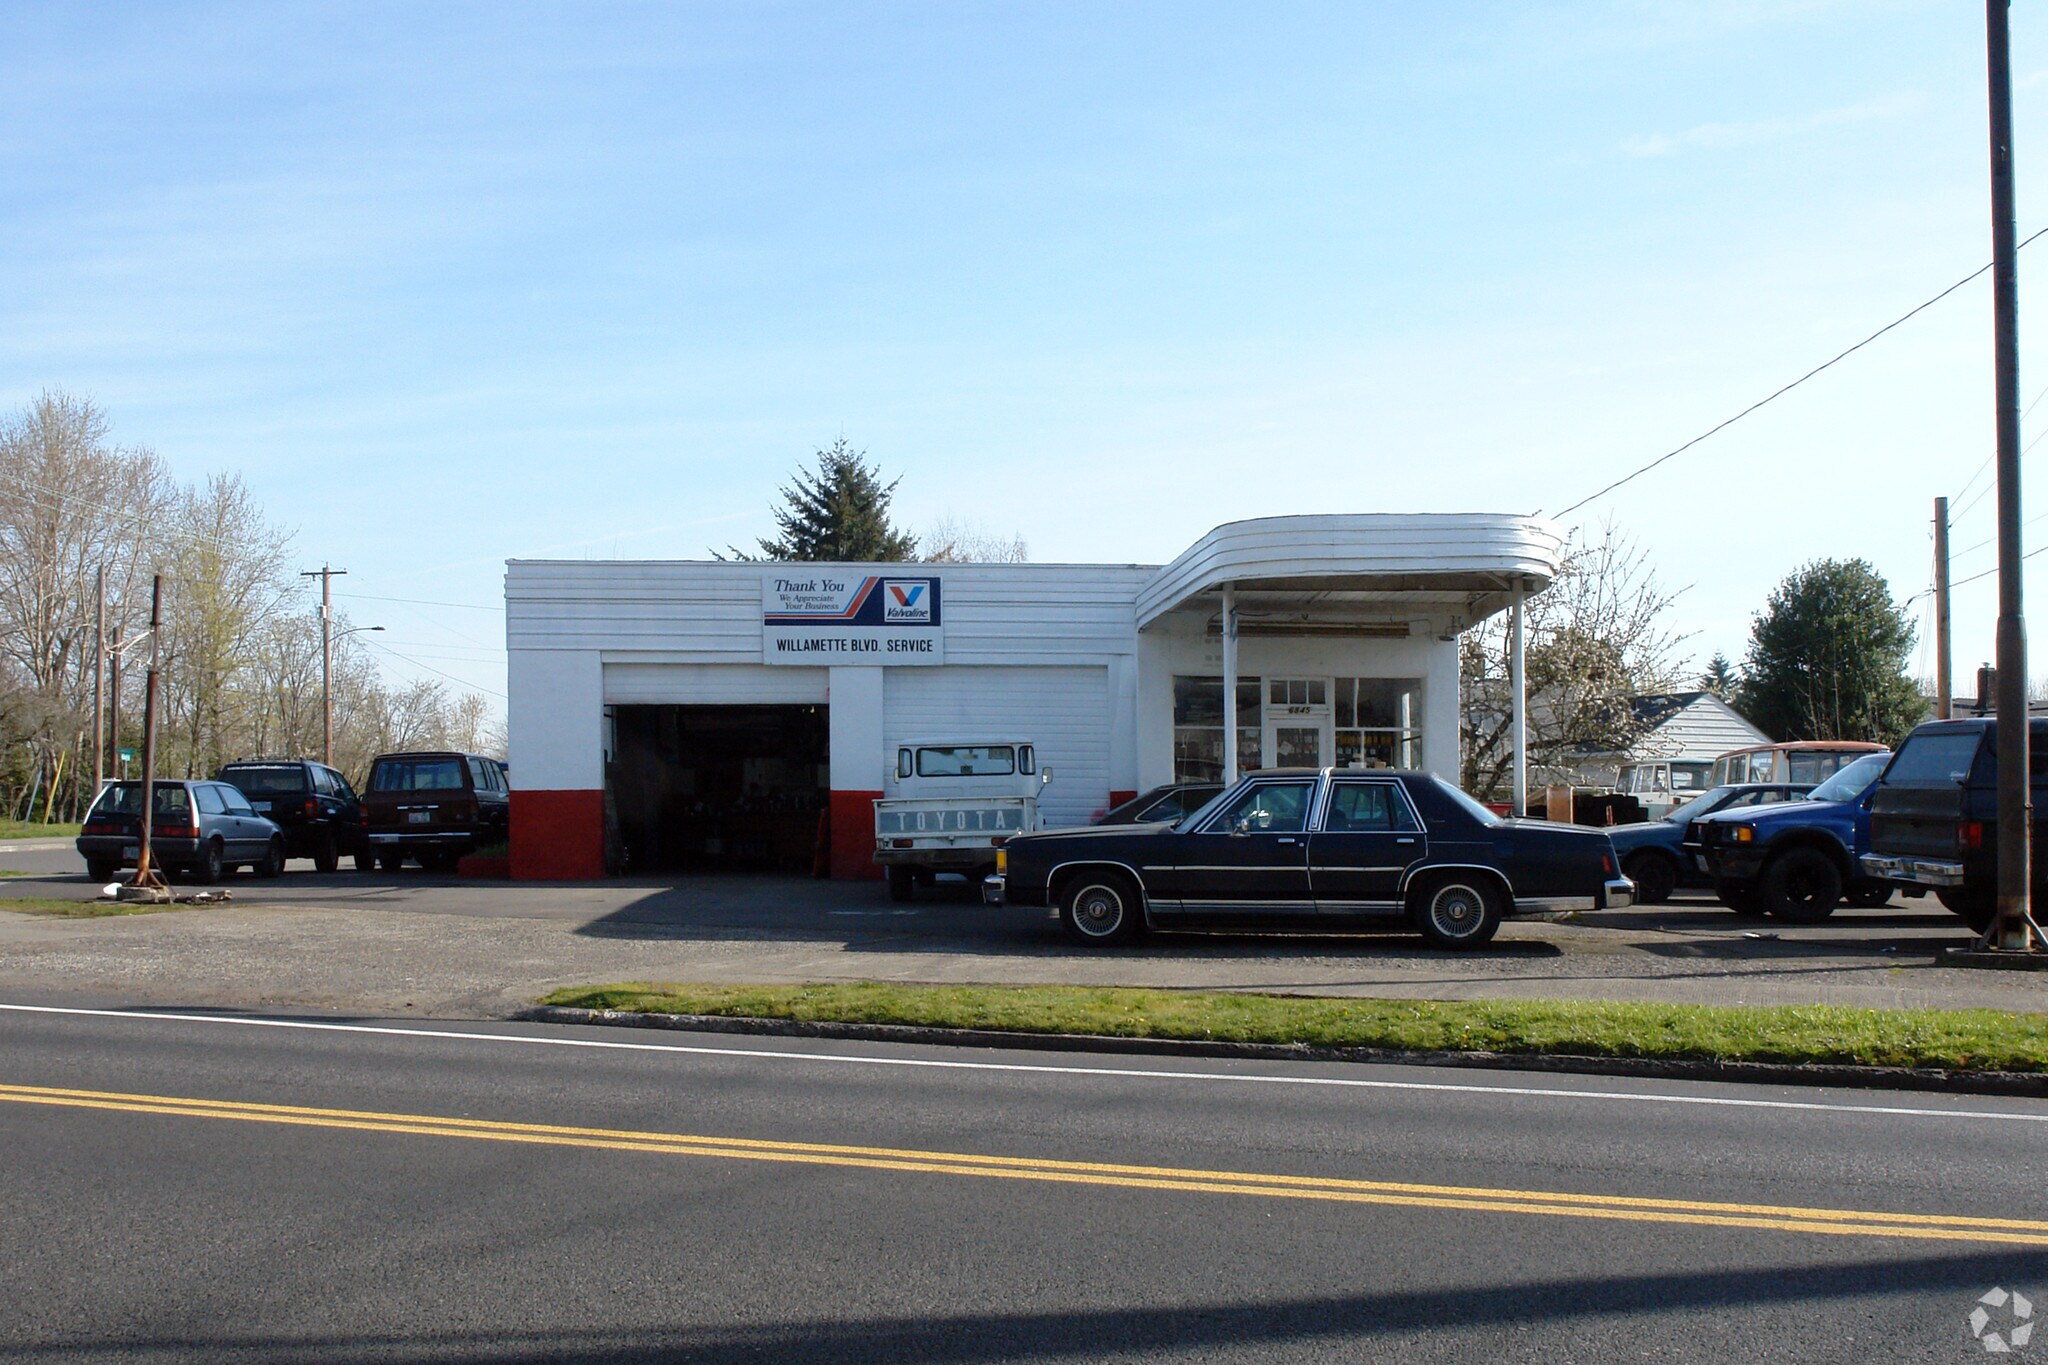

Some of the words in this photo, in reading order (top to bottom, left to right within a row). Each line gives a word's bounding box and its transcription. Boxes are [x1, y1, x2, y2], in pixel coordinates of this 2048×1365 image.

[774, 579, 817, 592] Thank
[821, 579, 845, 592] You
[779, 594, 792, 602] We
[793, 594, 835, 603] Appreciate
[785, 602, 803, 610] Your
[804, 602, 840, 610] Business
[887, 607, 929, 618] Valvoline
[776, 638, 848, 652] WILLAMETTE
[851, 638, 882, 652] BLVD.
[886, 639, 934, 652] SERVICE
[897, 810, 1006, 831] TOYOTA
